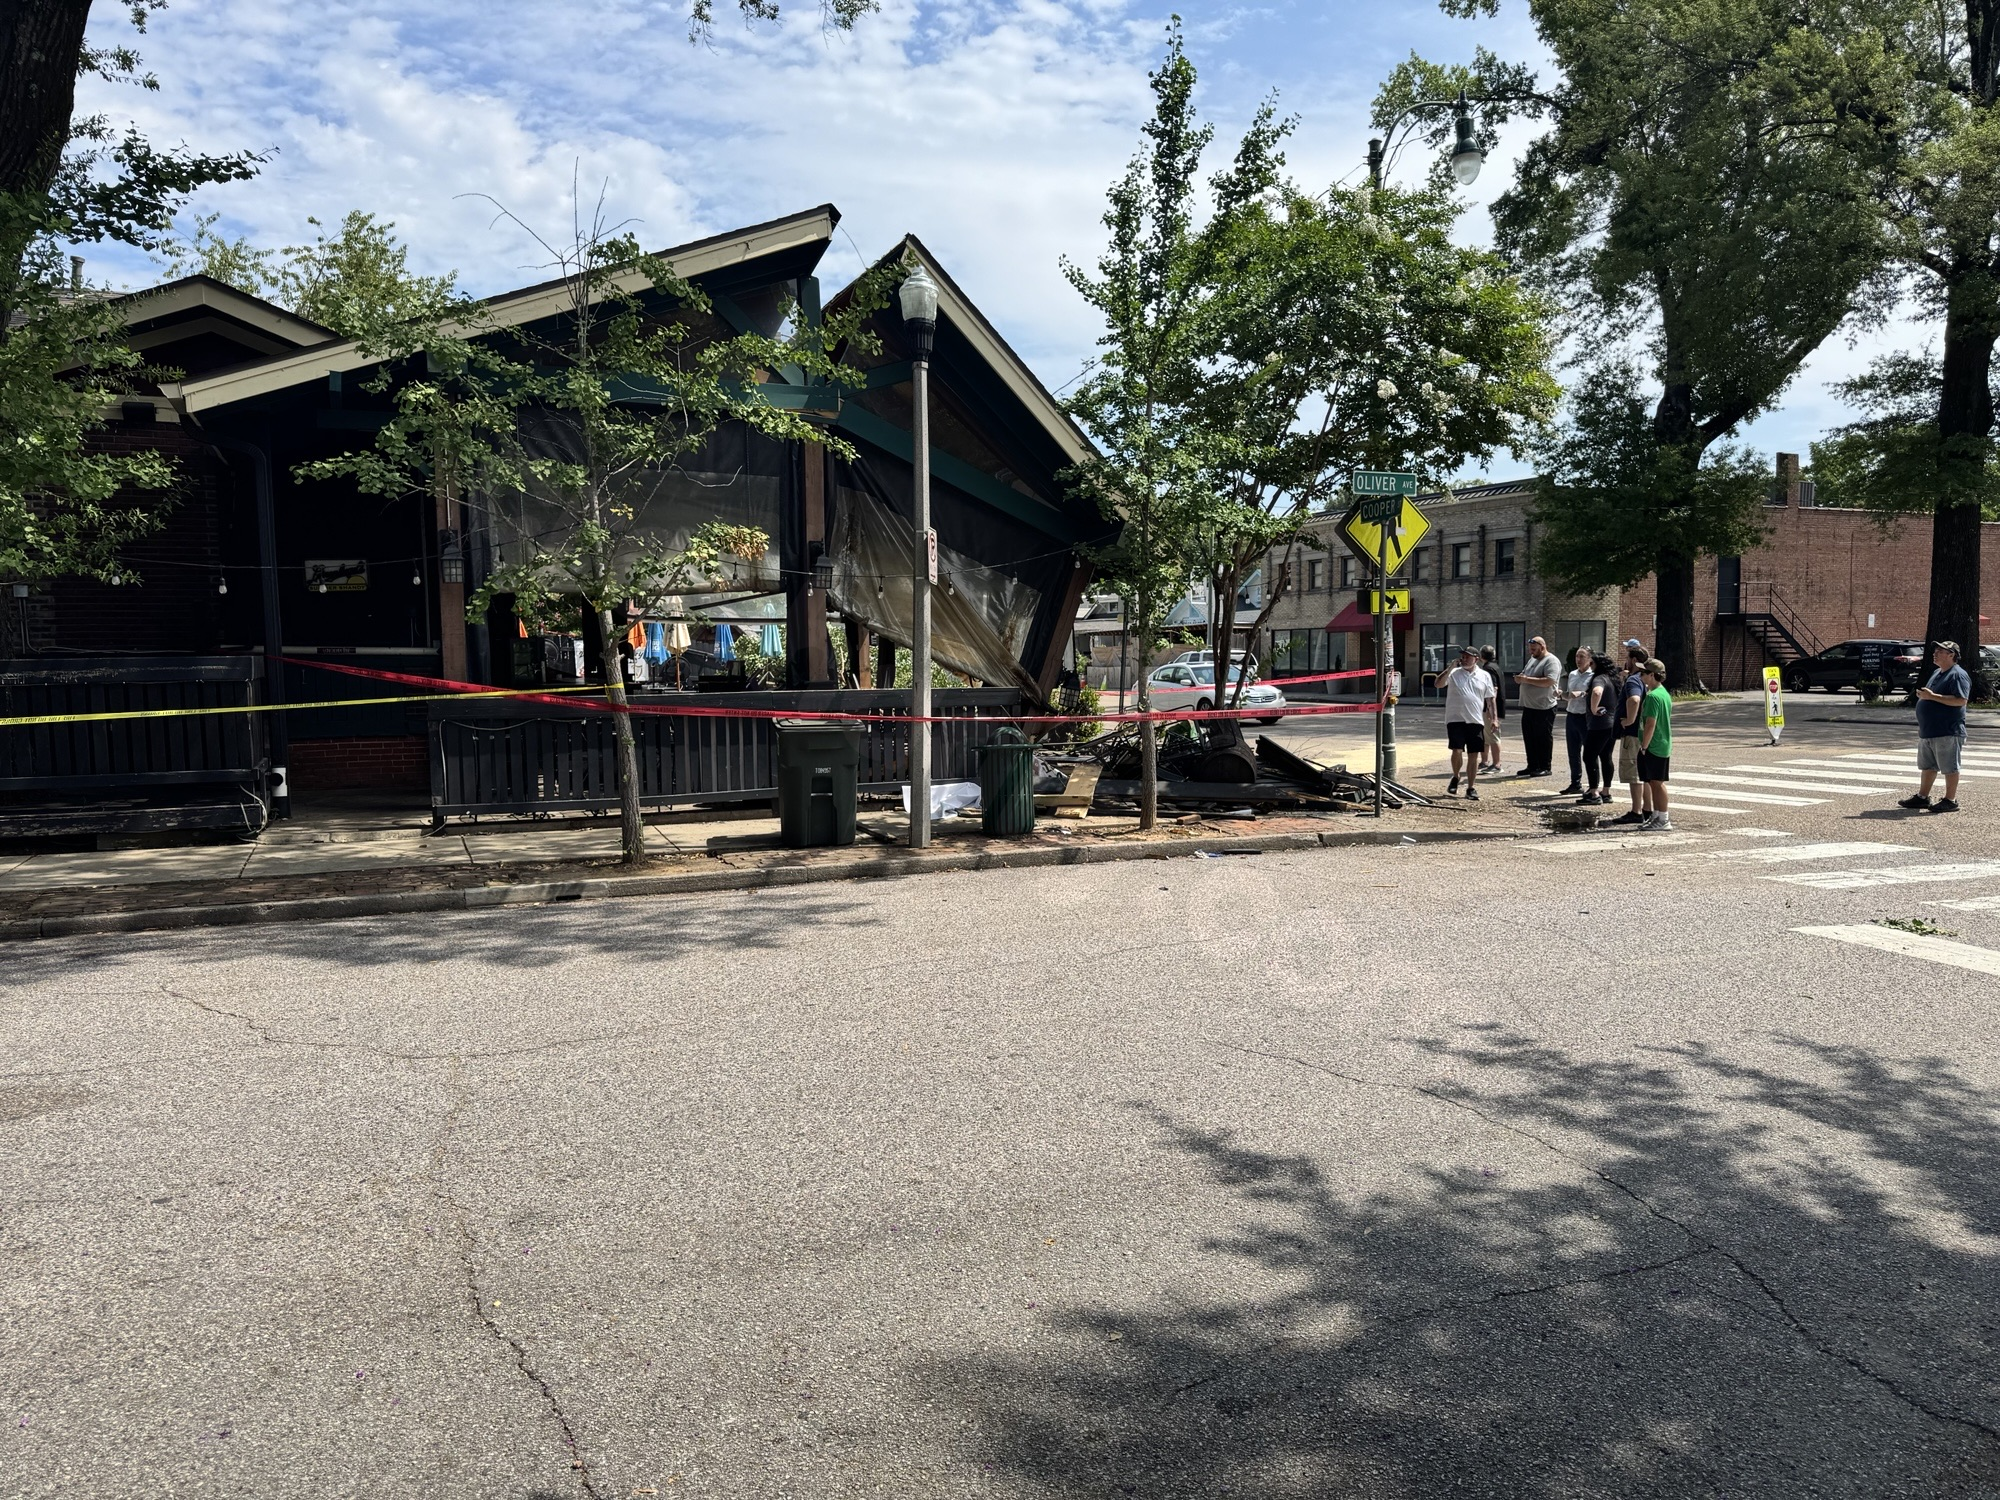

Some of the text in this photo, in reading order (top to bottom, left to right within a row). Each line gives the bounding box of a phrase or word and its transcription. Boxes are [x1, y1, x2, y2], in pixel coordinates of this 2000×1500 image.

[1357, 475, 1413, 491] OLIVER AVE
[1362, 500, 1396, 519] COOPER
